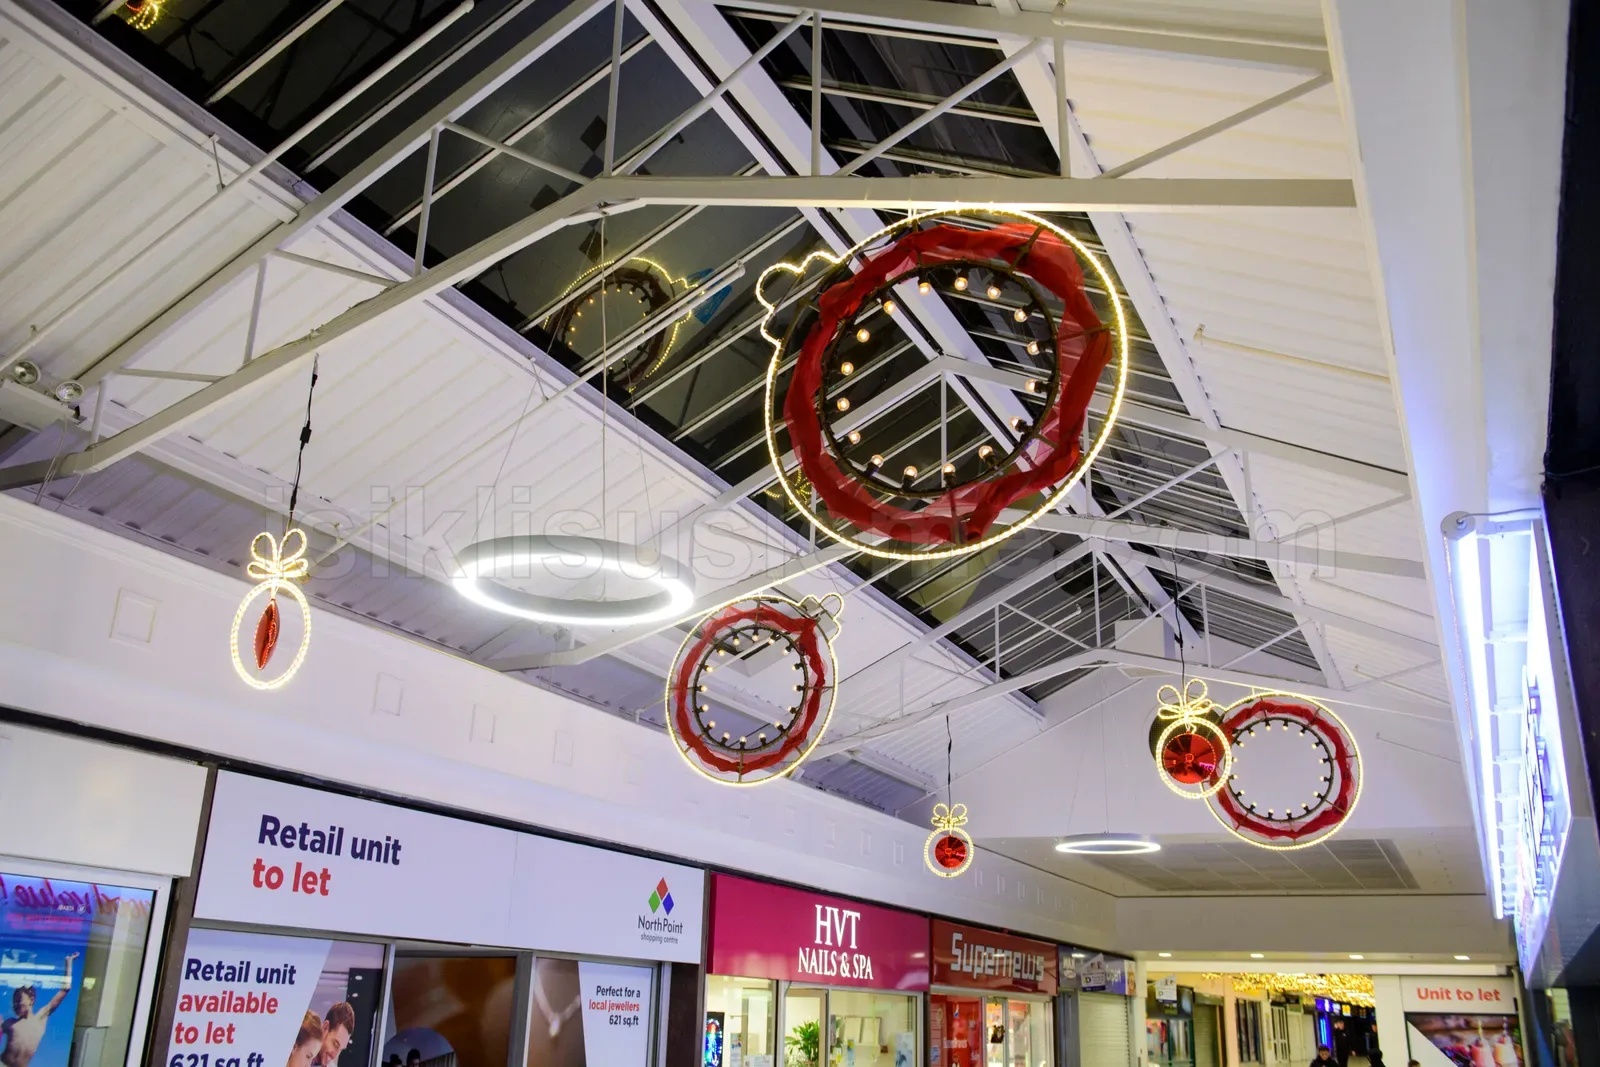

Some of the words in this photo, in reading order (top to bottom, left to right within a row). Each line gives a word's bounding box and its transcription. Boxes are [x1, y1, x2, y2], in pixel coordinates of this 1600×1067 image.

[258, 815, 344, 857] Retail
[351, 836, 401, 865] unit
[253, 858, 283, 890] to
[293, 862, 331, 896] let
[638, 915, 683, 934] NorthPoint
[815, 904, 861, 949] HVT
[641, 932, 663, 944] shopping
[663, 936, 679, 944] centre
[798, 947, 838, 977] NAILS
[840, 955, 851, 978] &
[853, 954, 874, 980] SPA
[951, 932, 1045, 981] Supernews
[184, 958, 250, 982] Retail
[256, 963, 297, 985] unit
[179, 991, 279, 1014] available
[596, 986, 623, 997] Perfect
[625, 987, 635, 998] for
[635, 990, 641, 998] a
[1417, 987, 1452, 1001] Unit
[1456, 988, 1474, 1001] to
[1478, 988, 1501, 1001] let
[589, 999, 607, 1011] local
[608, 1000, 640, 1013] jewellers
[609, 1015, 622, 1026] 621
[174, 1021, 199, 1045] to
[205, 1021, 236, 1045] let
[169, 1053, 210, 1067] 621
